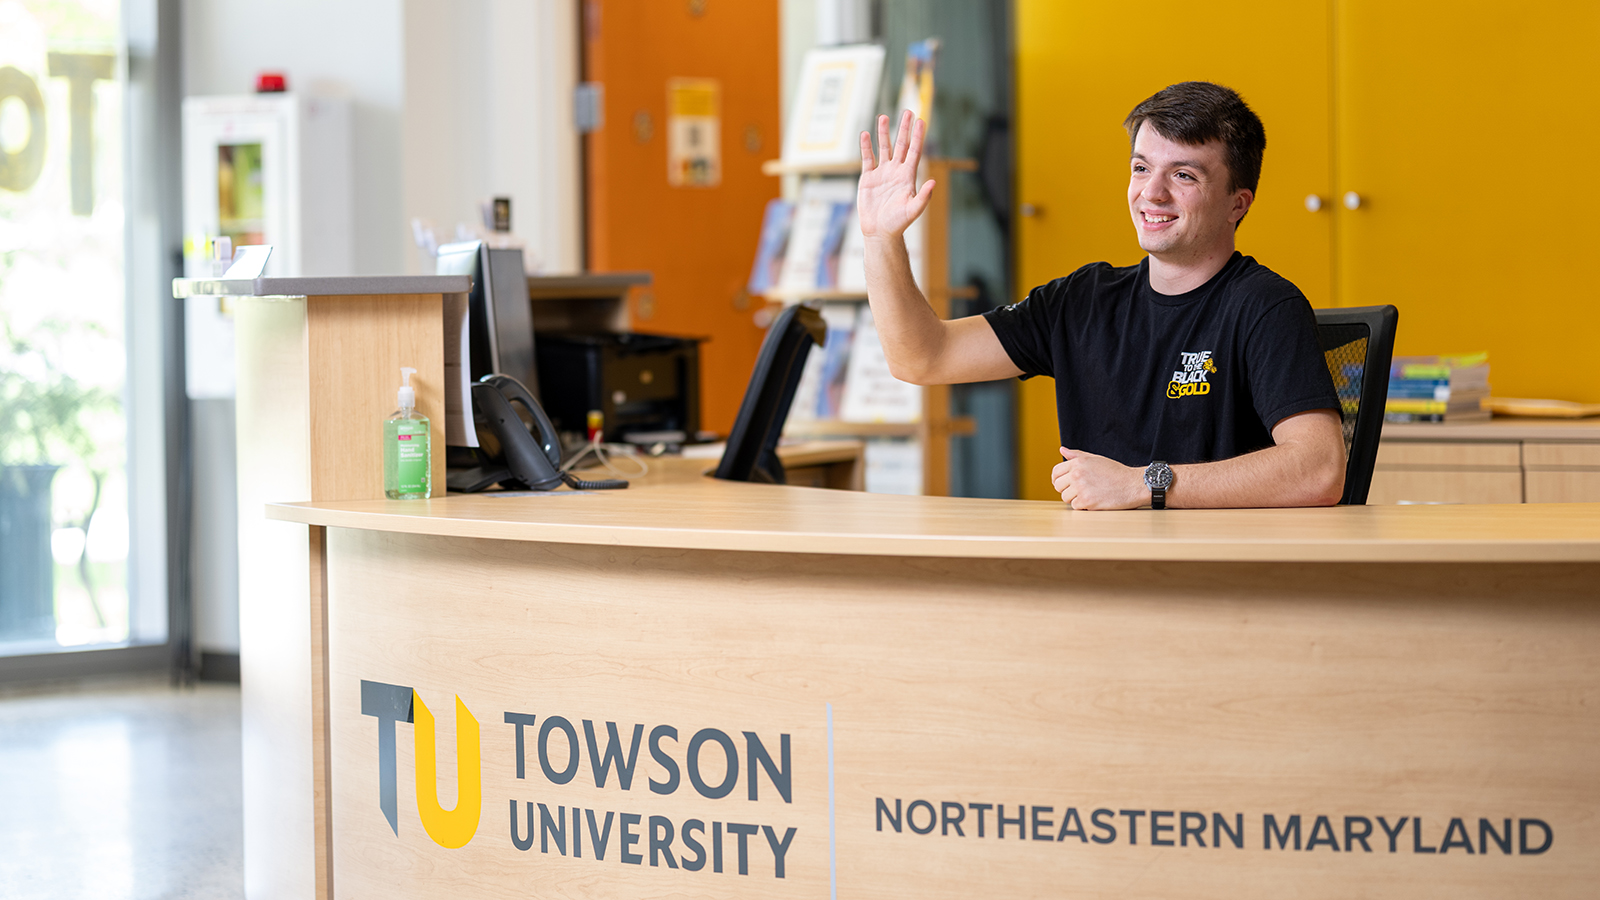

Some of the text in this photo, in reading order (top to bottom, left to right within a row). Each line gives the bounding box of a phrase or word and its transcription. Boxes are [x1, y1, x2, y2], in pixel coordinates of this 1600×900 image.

[1172, 370, 1208, 384] BLACK
[1181, 351, 1212, 364] TRUE
[360, 679, 482, 849] TU
[504, 711, 792, 804] TOWSON
[509, 799, 798, 879] UNIVERSITY
[875, 797, 1554, 856] NORTHEASTERN MARYLAND
